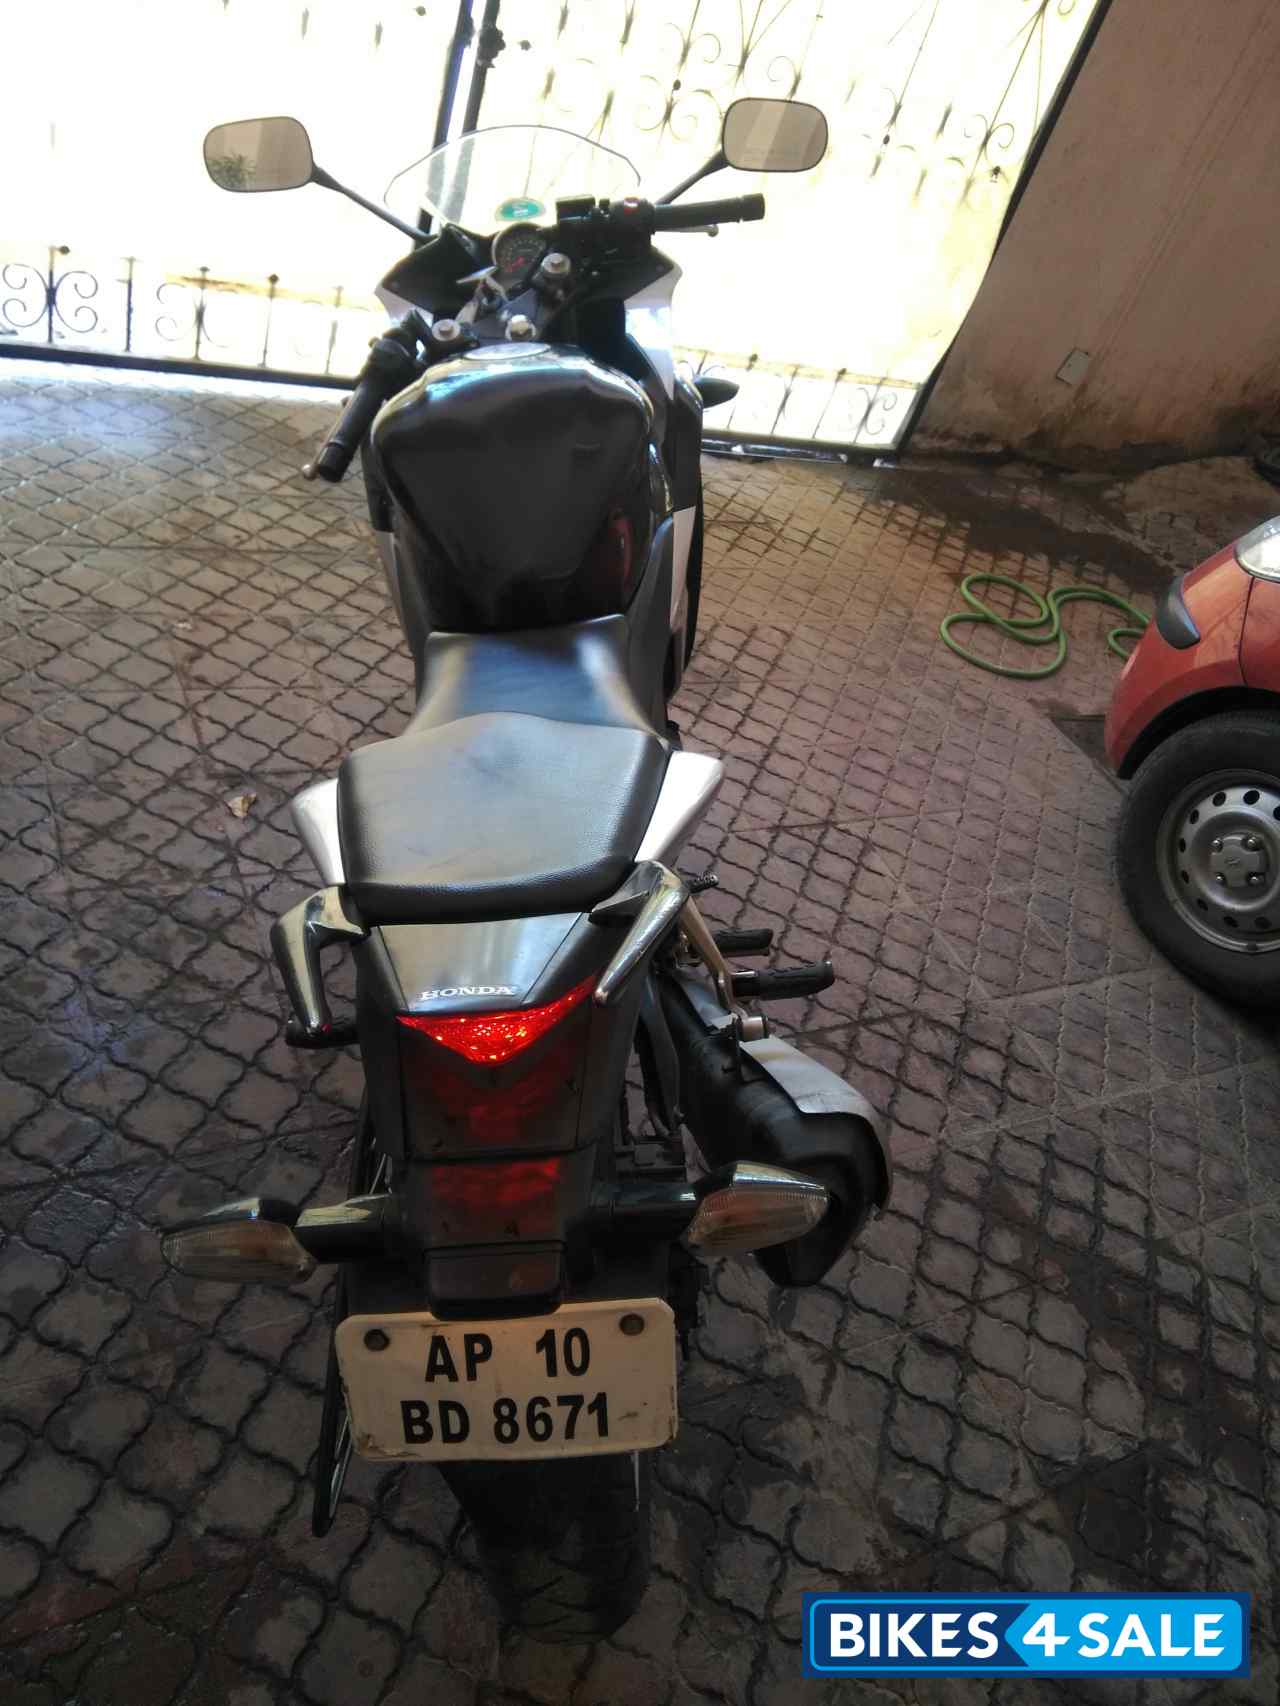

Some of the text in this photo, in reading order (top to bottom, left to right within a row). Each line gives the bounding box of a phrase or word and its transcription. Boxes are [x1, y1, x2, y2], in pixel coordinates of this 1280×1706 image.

[420, 986, 516, 1001] HONDA
[425, 1327, 591, 1382] AP 10
[401, 1392, 609, 1444] BD 8671
